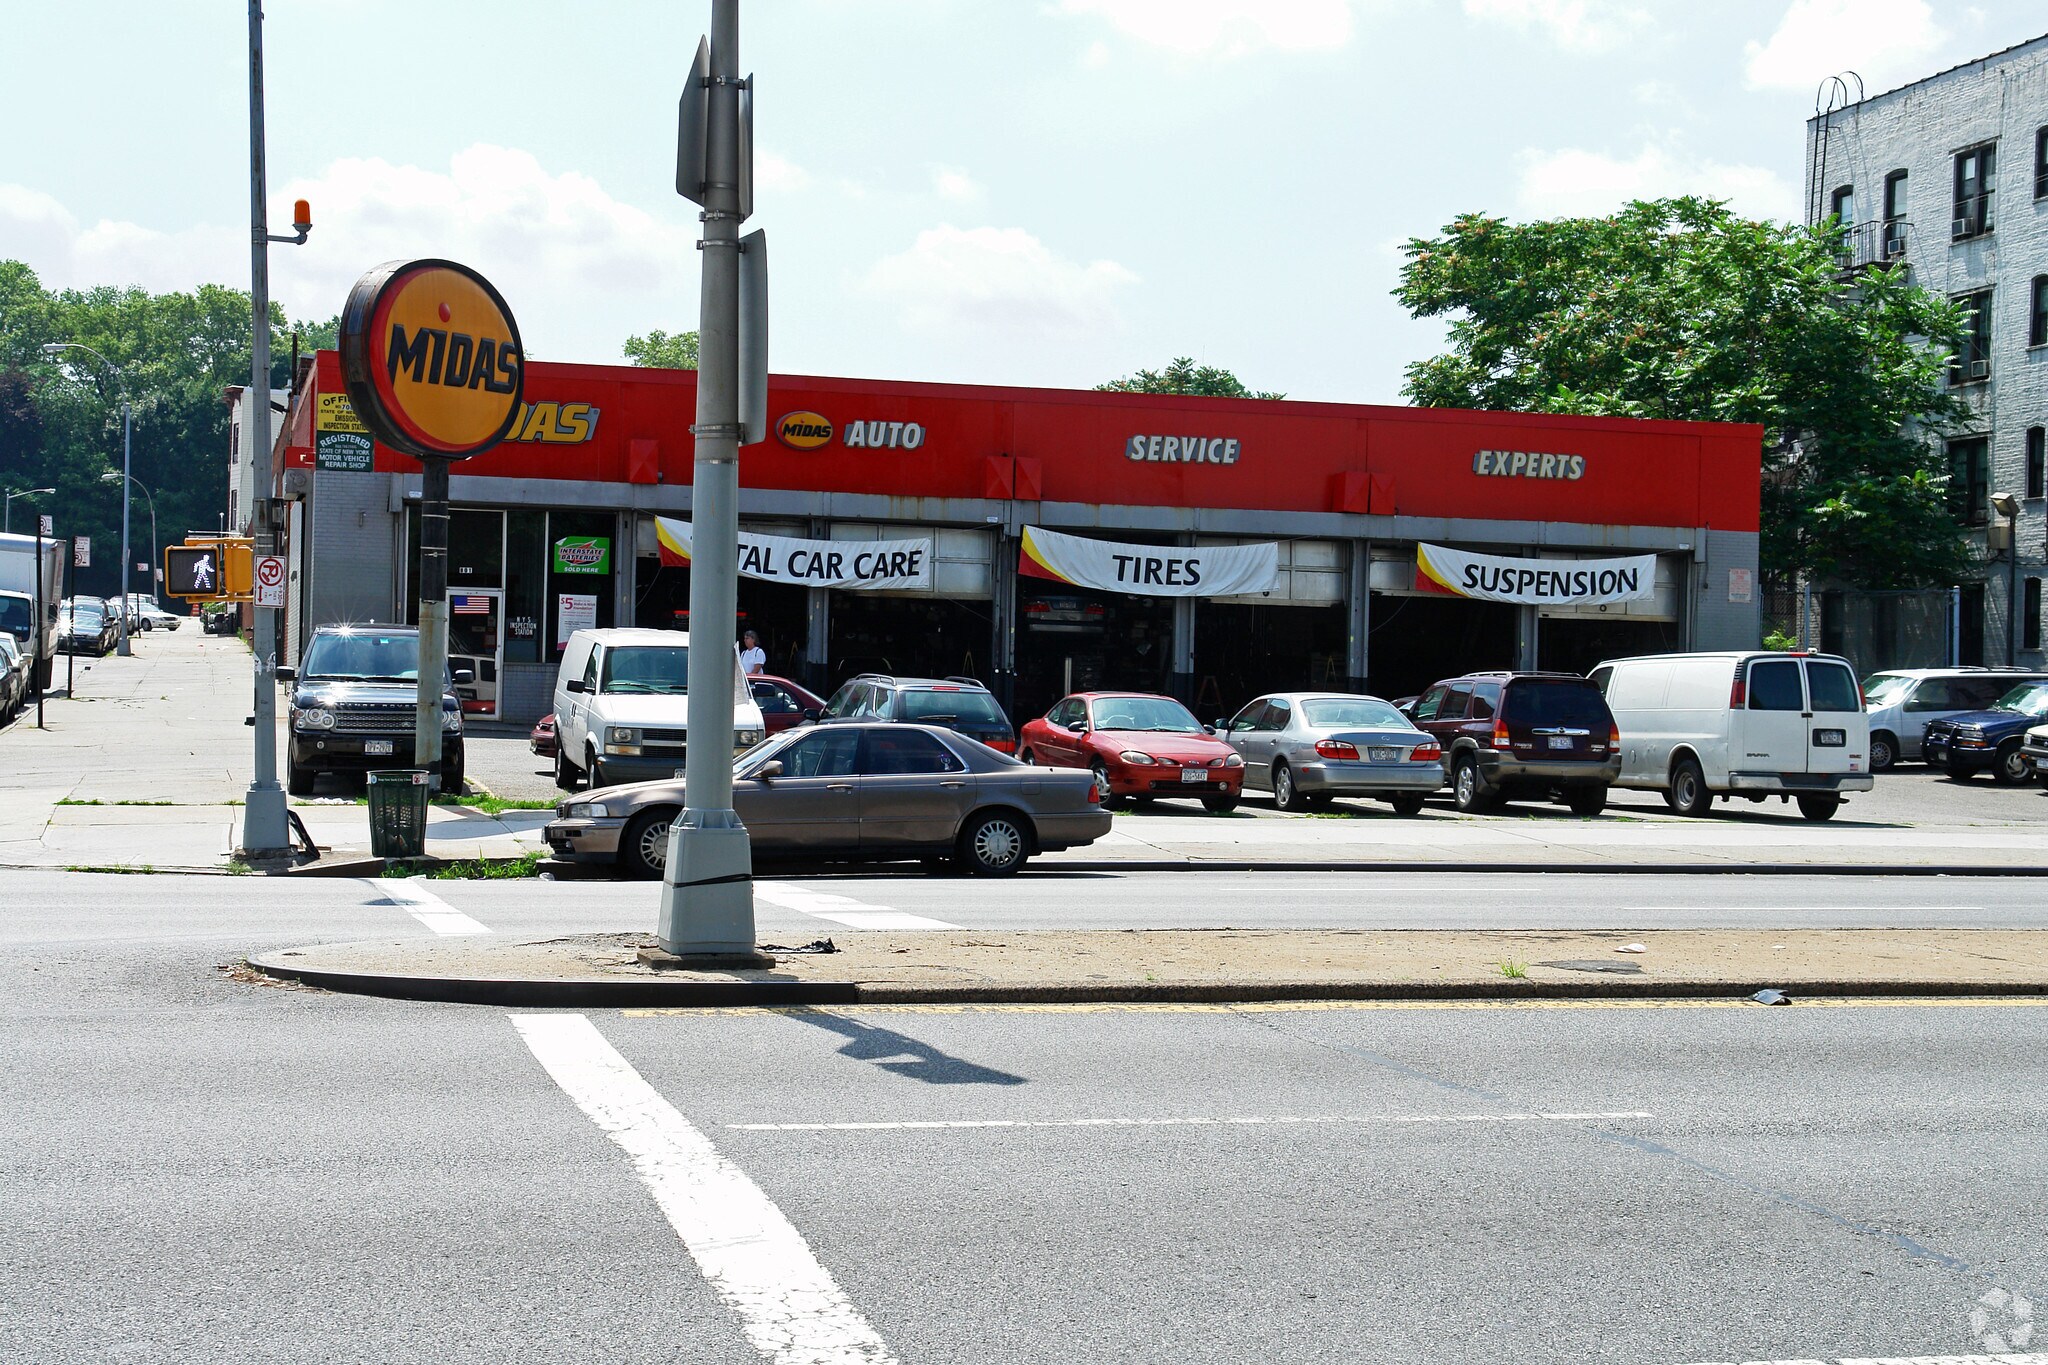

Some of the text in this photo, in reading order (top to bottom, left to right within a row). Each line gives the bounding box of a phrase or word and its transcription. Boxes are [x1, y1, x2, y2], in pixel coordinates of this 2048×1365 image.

[387, 323, 518, 395] MIDAS
[323, 396, 348, 406] OFFI
[323, 421, 350, 430] INSPECTION
[782, 423, 831, 438] MIDAS
[319, 433, 371, 449] REGISTERED
[847, 420, 921, 449] AUTO
[1130, 435, 1238, 464] SERVICE
[1477, 449, 1584, 480] EXPERTS
[559, 547, 604, 556] INTERSTATE
[560, 554, 601, 562] BATTERIES
[737, 543, 923, 580] TAL CAR CARE
[1112, 554, 1201, 586] TIRES
[1462, 563, 1638, 597] SUSPENSION
[560, 597, 574, 611] $5
[509, 622, 537, 630] INSPECTION
[514, 628, 533, 636] STATION
